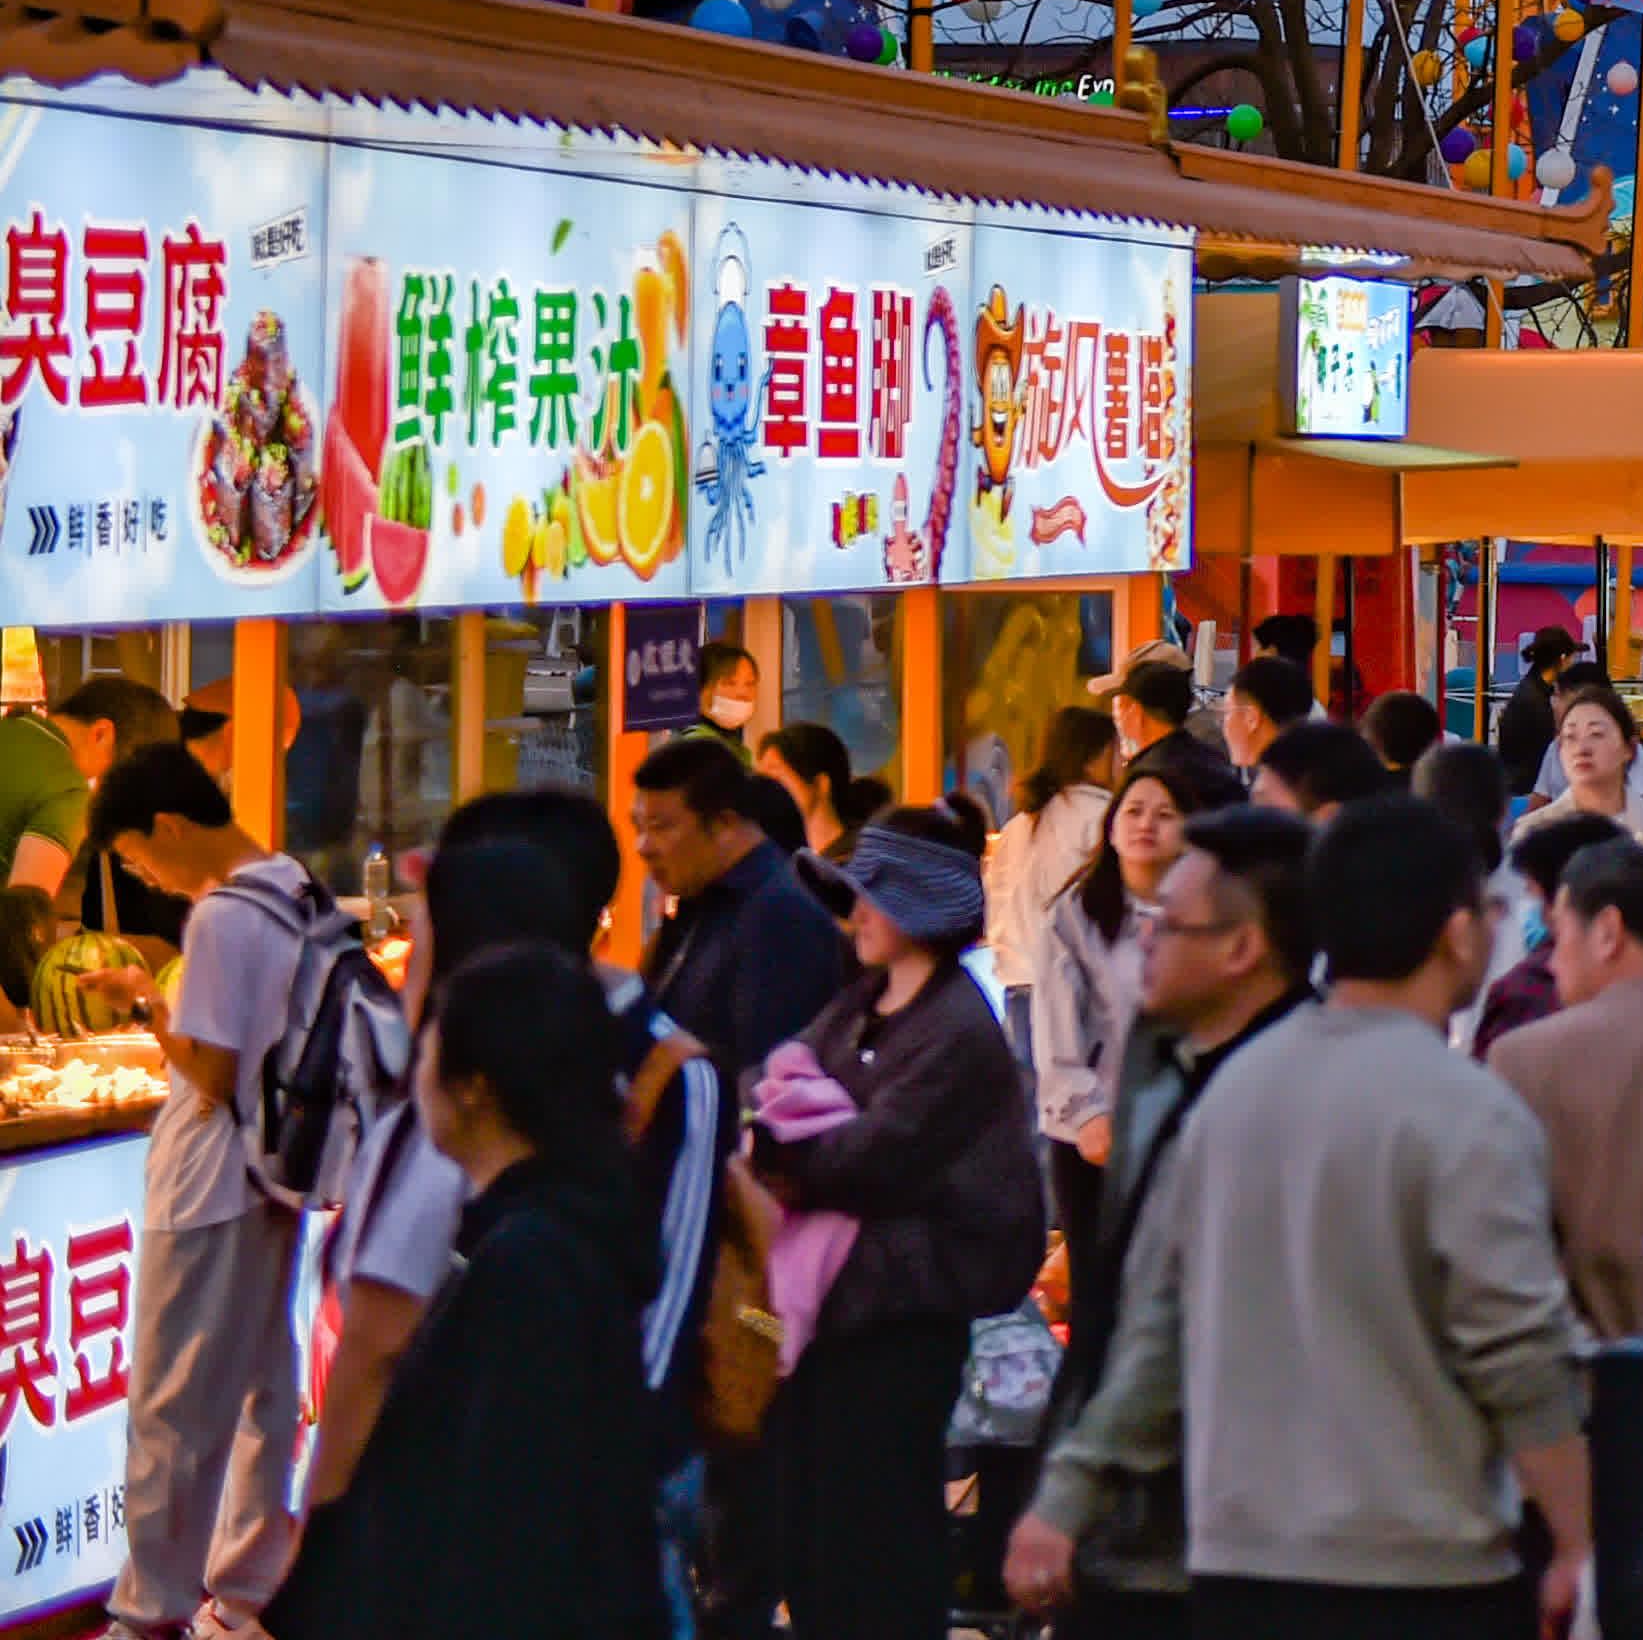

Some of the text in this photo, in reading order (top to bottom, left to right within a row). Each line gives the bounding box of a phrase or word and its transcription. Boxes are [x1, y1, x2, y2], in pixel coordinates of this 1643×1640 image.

[1, 210, 226, 410] 臭豆腐
[395, 272, 641, 452] 鲜榨果汁
